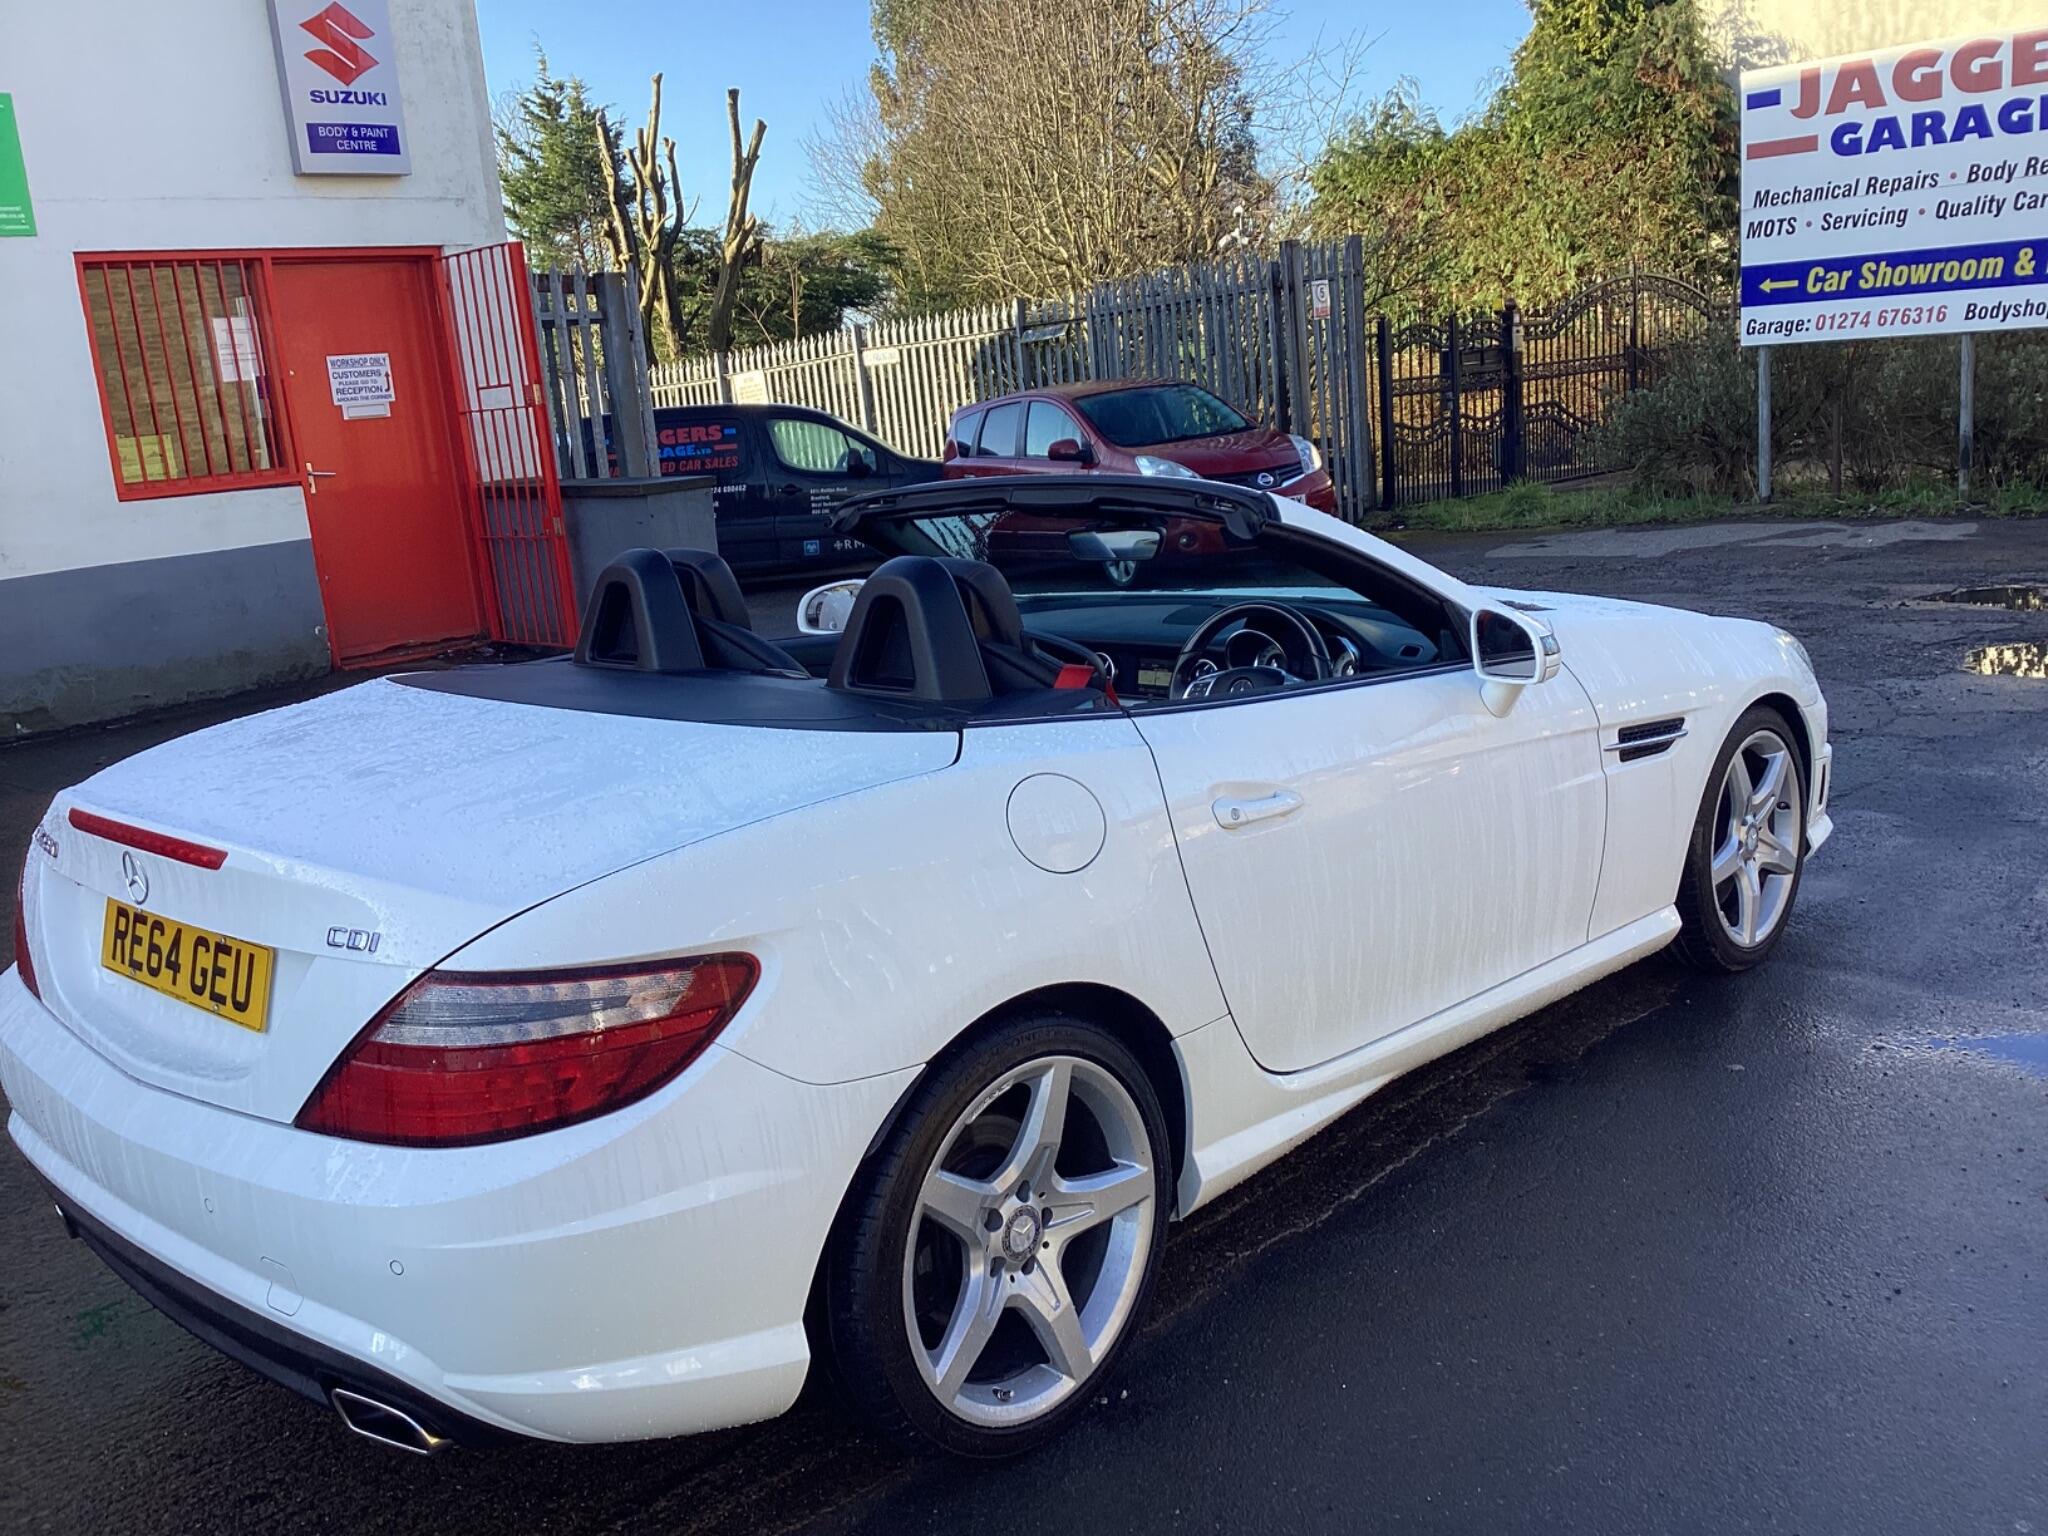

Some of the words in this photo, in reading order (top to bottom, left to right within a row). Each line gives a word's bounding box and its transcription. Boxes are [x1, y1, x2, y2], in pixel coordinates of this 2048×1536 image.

[1790, 28, 2048, 120] JAGGE
[309, 89, 388, 106] SUZUKI
[318, 126, 349, 137] BODY
[351, 127, 359, 138] &
[360, 127, 389, 138] PAINT
[336, 140, 378, 151] CENTRE
[1753, 177, 1860, 209] Mechanical
[1865, 169, 1940, 197] Repairs
[1966, 159, 2018, 184] Body
[1746, 216, 1798, 240] MOTS
[1820, 206, 1909, 232] Servicing
[1935, 194, 2006, 220] Quality
[2013, 190, 2048, 212] Car
[1806, 266, 1853, 295] Car
[1858, 256, 2005, 291] Showroom
[2014, 247, 2036, 277] &
[1745, 317, 1812, 337] Garage:
[1814, 310, 1872, 332] 01274
[1876, 304, 1949, 328] 676316
[1964, 298, 2048, 323] Bodysho
[329, 357, 368, 368] WORKSHOP
[369, 356, 387, 366] ONLY
[332, 369, 382, 380] CUSTOMERS
[336, 386, 383, 395] RECEPTION
[656, 425, 722, 445] GERS
[679, 459, 702, 472] CAR
[704, 456, 739, 470] SALES
[326, 926, 382, 953] CDI
[111, 905, 183, 986] RE64
[189, 935, 255, 1013] GEU
